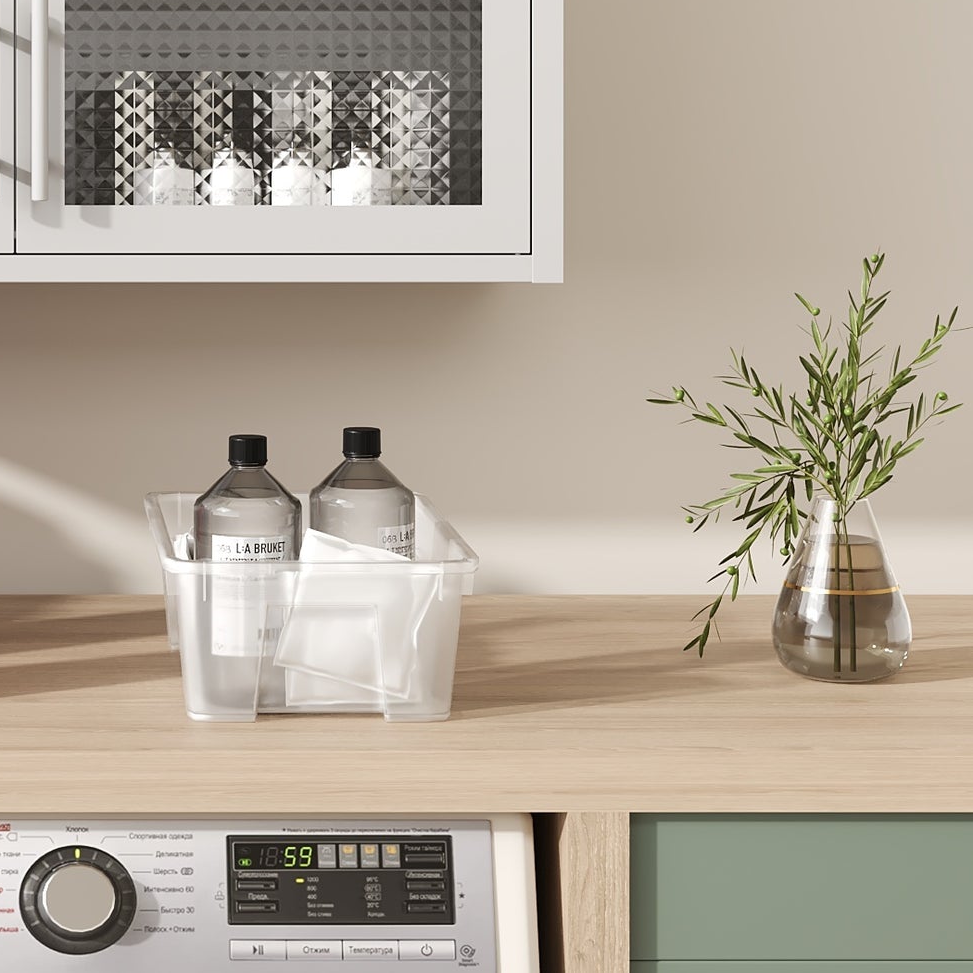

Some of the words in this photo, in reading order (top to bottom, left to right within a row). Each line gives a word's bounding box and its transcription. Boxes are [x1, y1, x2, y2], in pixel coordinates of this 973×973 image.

[236, 542, 251, 554] L:A
[254, 541, 286, 554] BRUKET
[302, 946, 330, 954] Отжим
[348, 946, 393, 955] Температура
